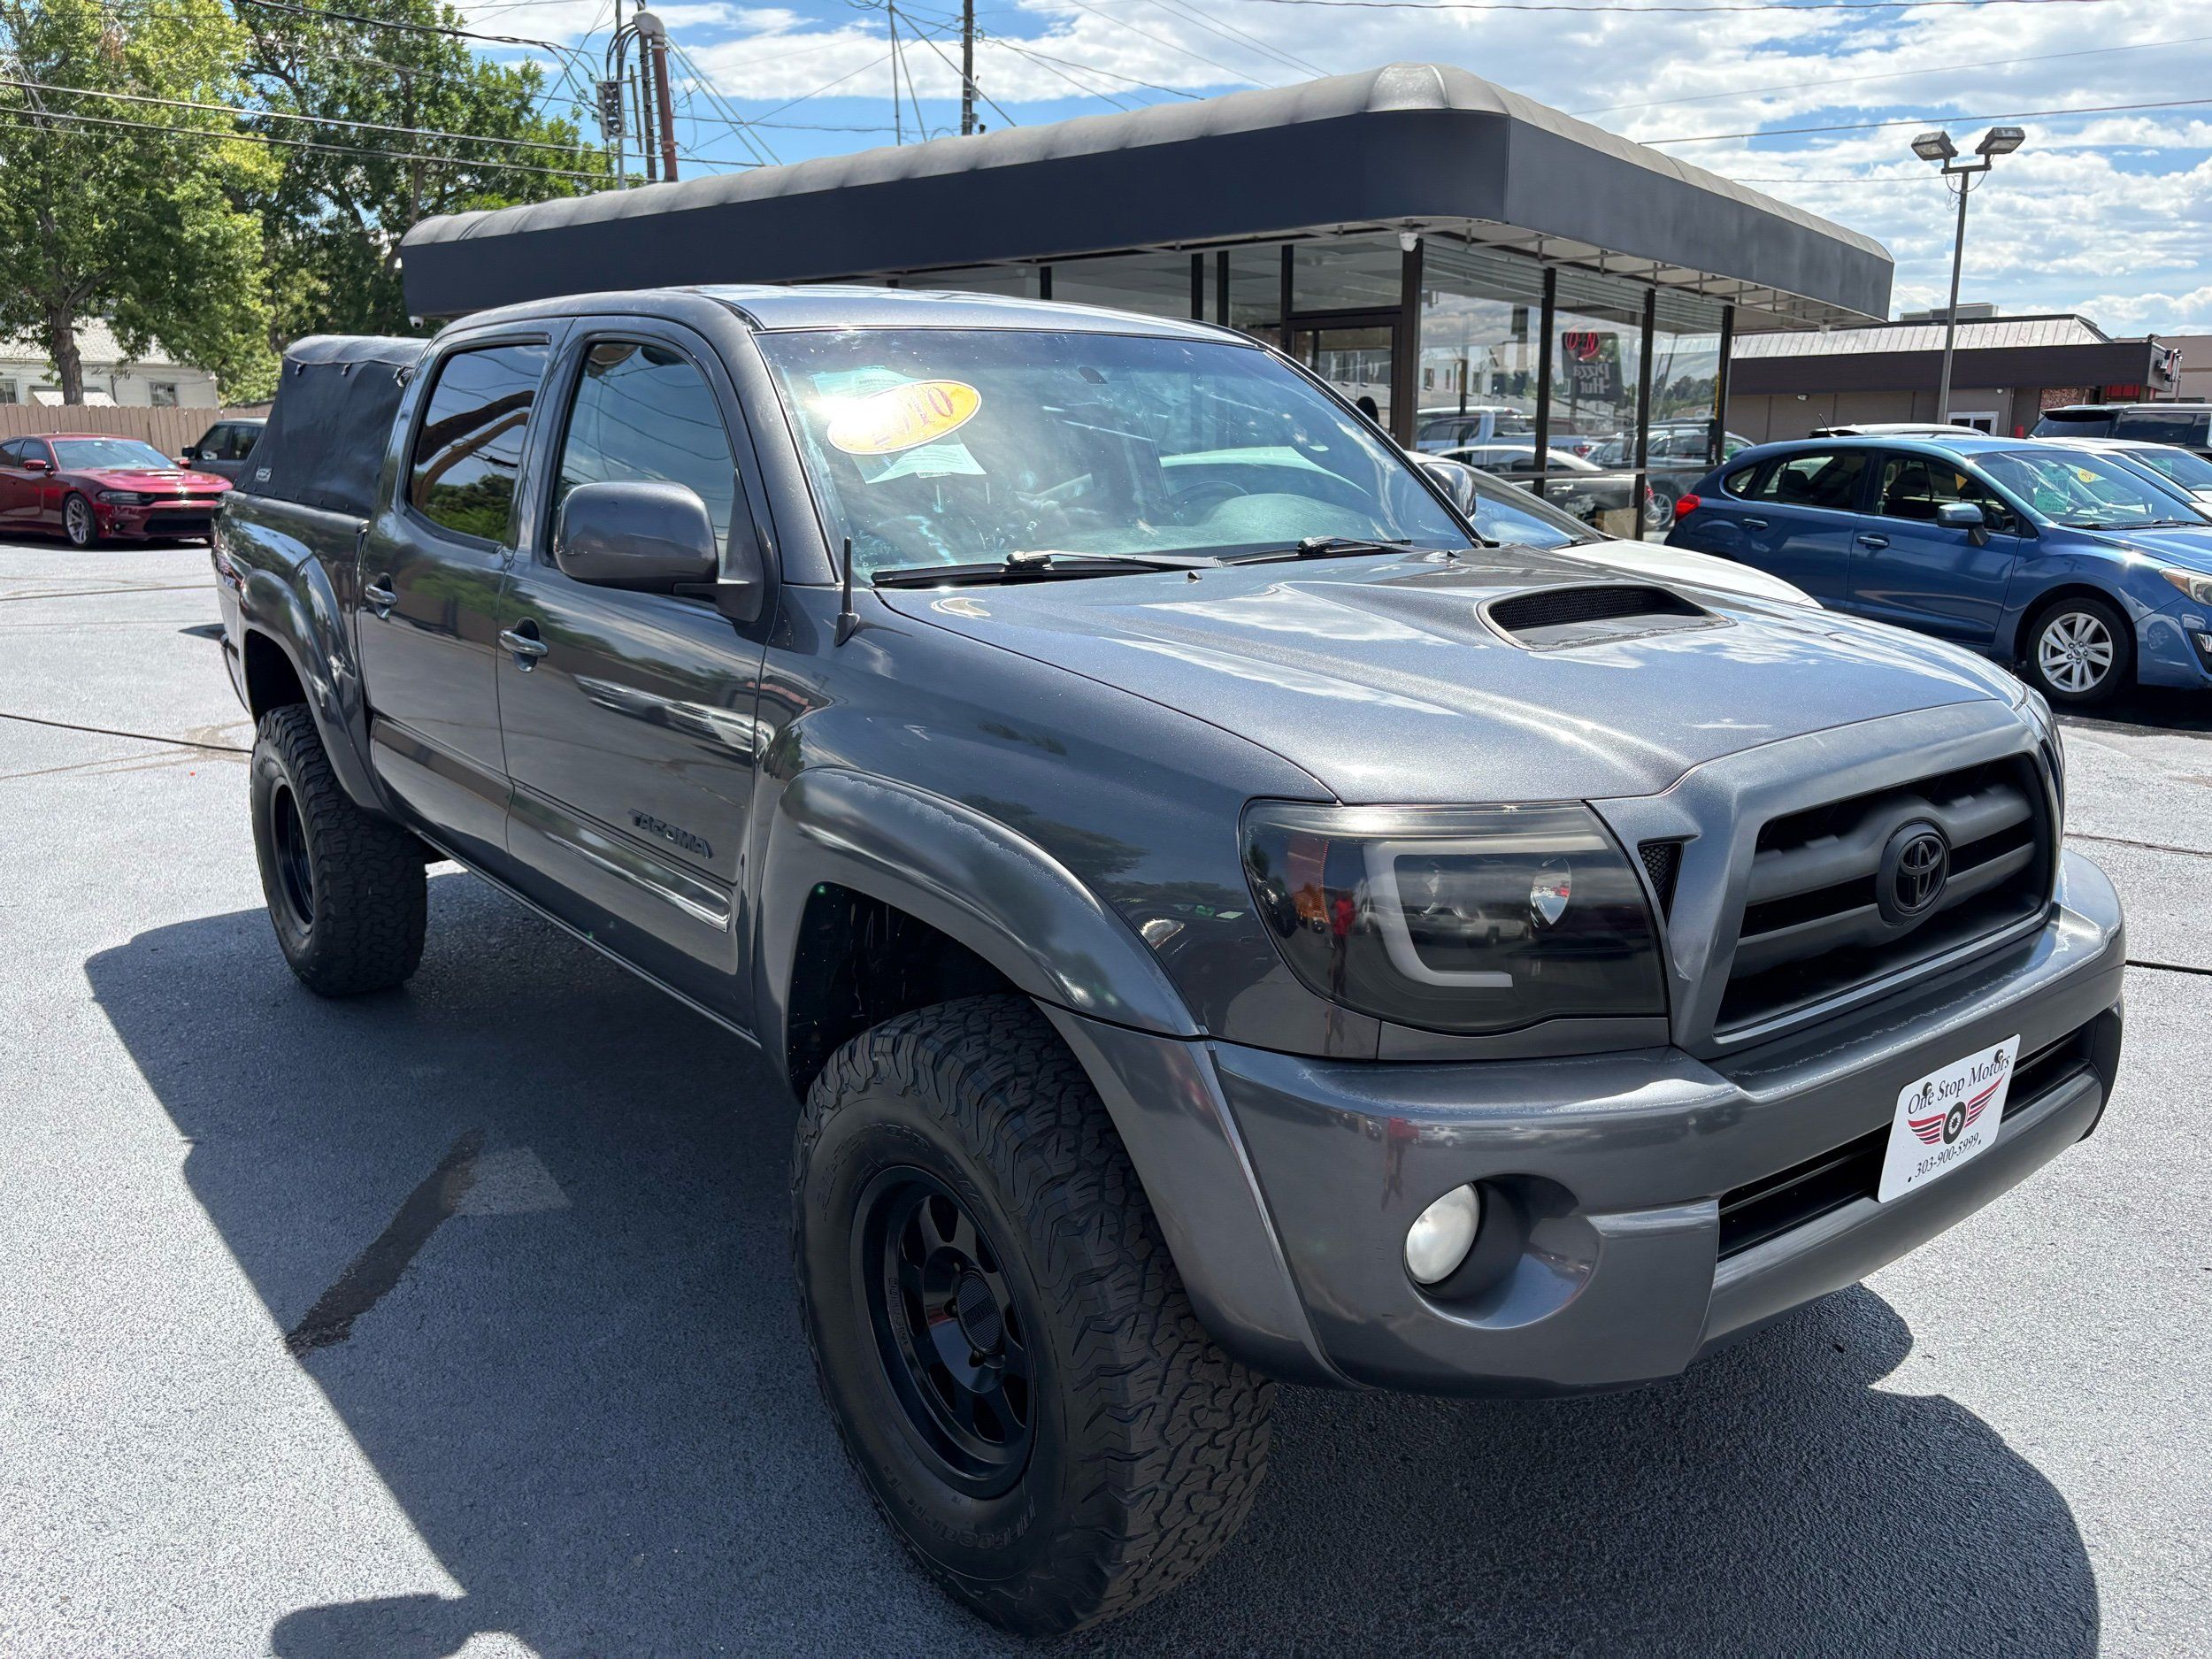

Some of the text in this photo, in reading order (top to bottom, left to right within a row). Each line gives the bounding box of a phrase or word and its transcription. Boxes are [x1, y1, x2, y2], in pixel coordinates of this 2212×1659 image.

[1568, 329, 1596, 351] ON
[865, 387, 955, 446] 10
[628, 808, 713, 859] TACOMA
[1908, 1054, 2011, 1115] One Stop Motors
[1915, 1133, 1979, 1179] 303-900-5999
